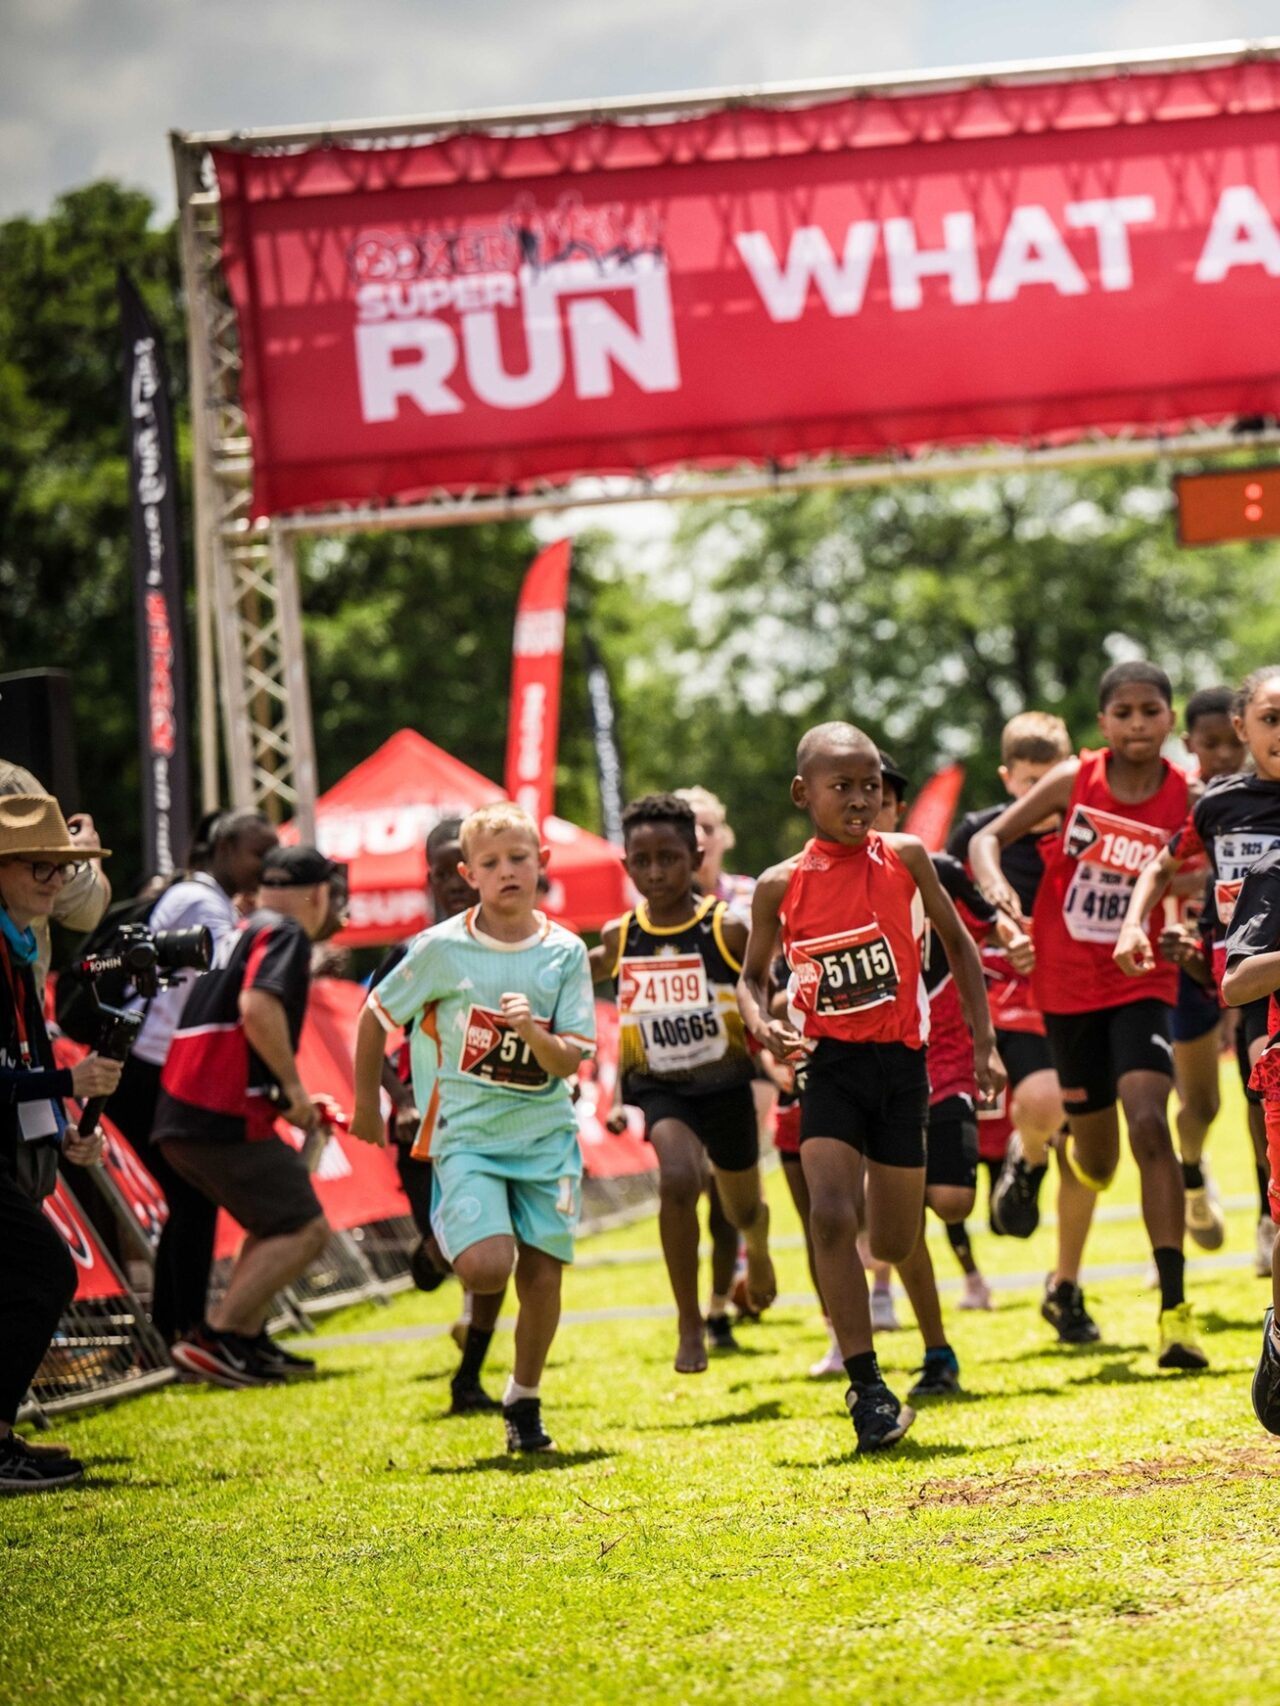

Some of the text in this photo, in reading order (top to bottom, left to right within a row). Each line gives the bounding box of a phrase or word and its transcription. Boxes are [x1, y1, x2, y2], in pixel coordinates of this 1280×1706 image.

[734, 194, 1156, 323] WHAT
[355, 272, 517, 322] SUPER
[354, 252, 681, 424] RUN
[1100, 832, 1158, 871] 1902
[89, 956, 122, 973] RONIN
[822, 942, 890, 988] 5115
[645, 974, 701, 1004] 4199
[651, 1011, 720, 1048] 40665
